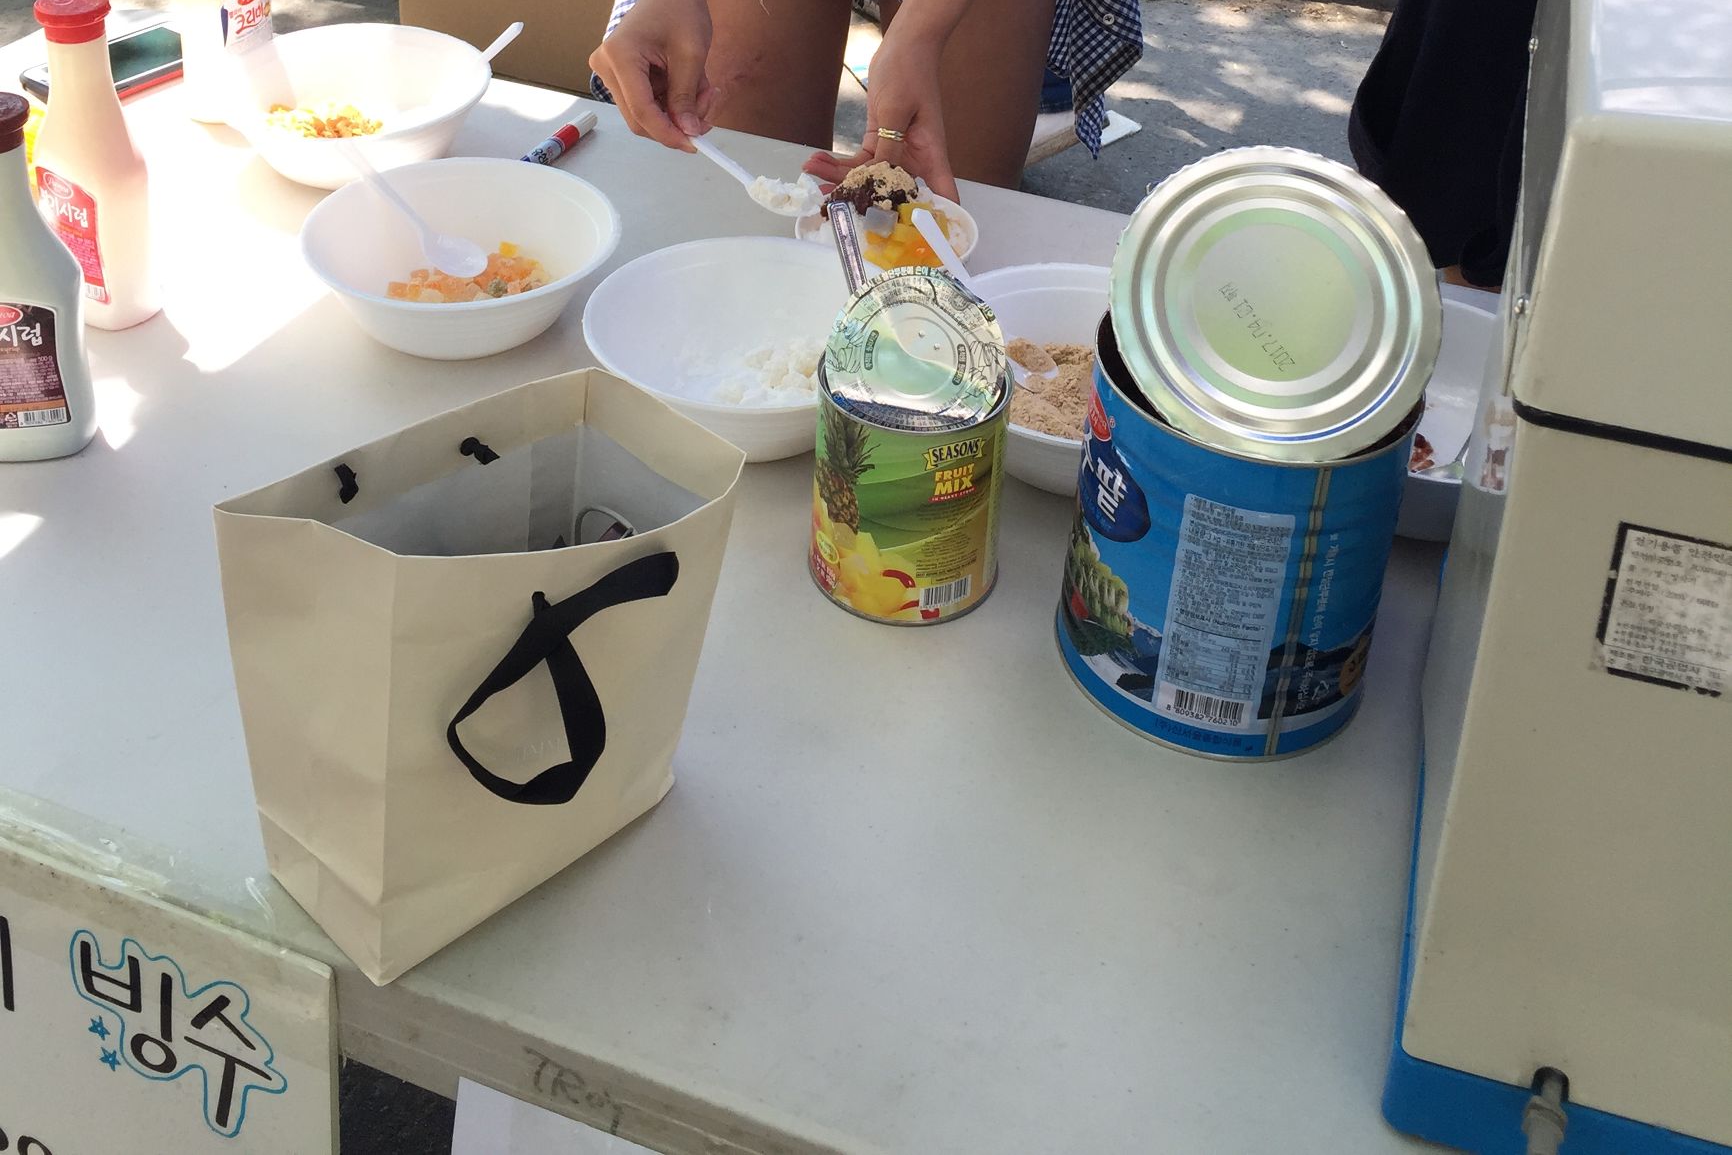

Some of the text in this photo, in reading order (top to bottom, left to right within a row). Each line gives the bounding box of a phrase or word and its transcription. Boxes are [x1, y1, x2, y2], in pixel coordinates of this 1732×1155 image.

[931, 438, 980, 464] SEASONS
[934, 462, 975, 483] FRUIT
[933, 474, 973, 496] MIX
[79, 939, 273, 1129] 빙수
